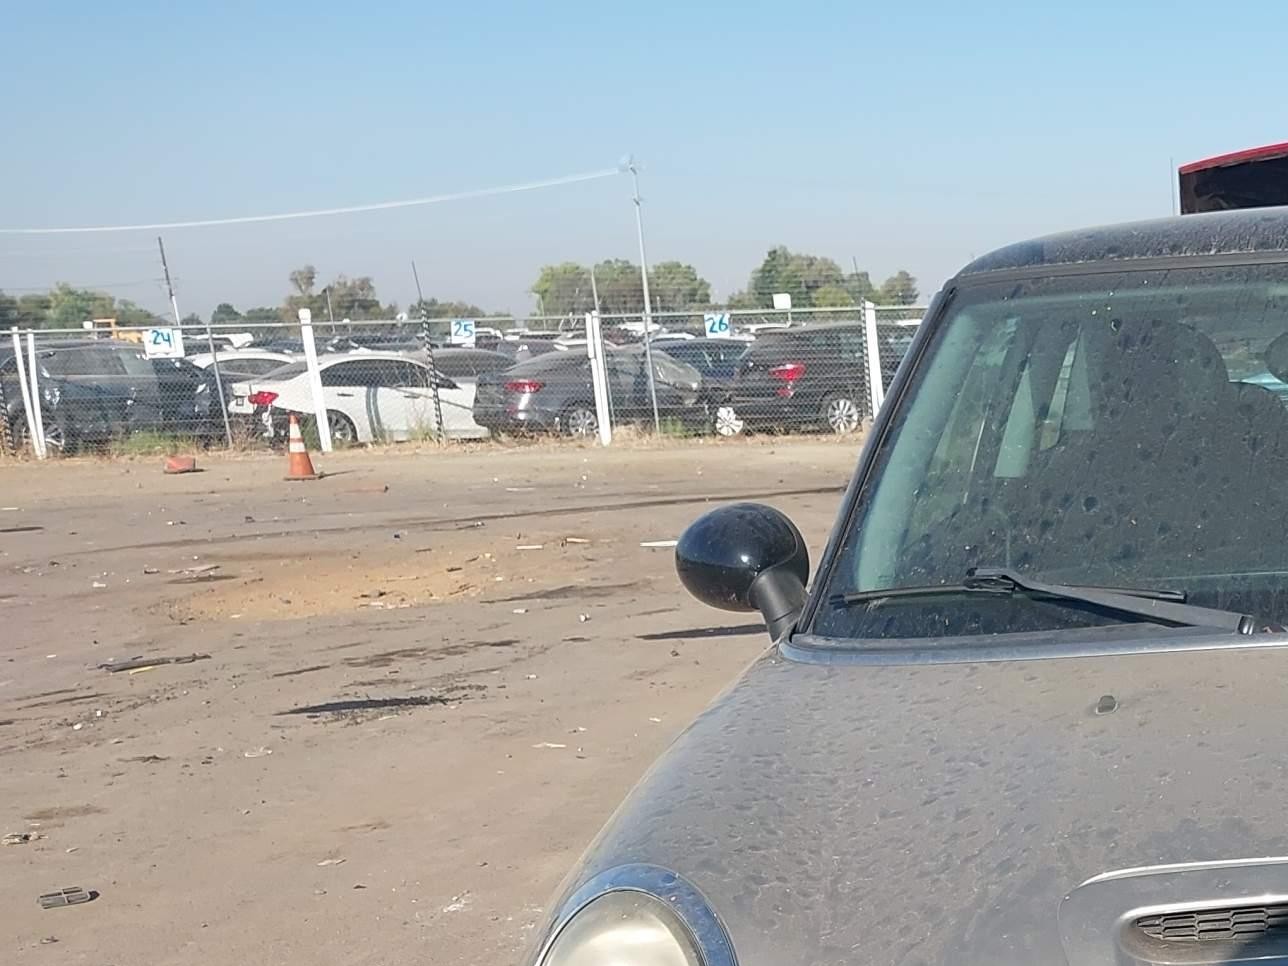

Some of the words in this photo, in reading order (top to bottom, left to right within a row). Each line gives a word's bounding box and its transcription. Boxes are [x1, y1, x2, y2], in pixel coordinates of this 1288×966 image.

[453, 320, 474, 338] 25
[705, 312, 729, 334] 26
[151, 329, 172, 349] 24
